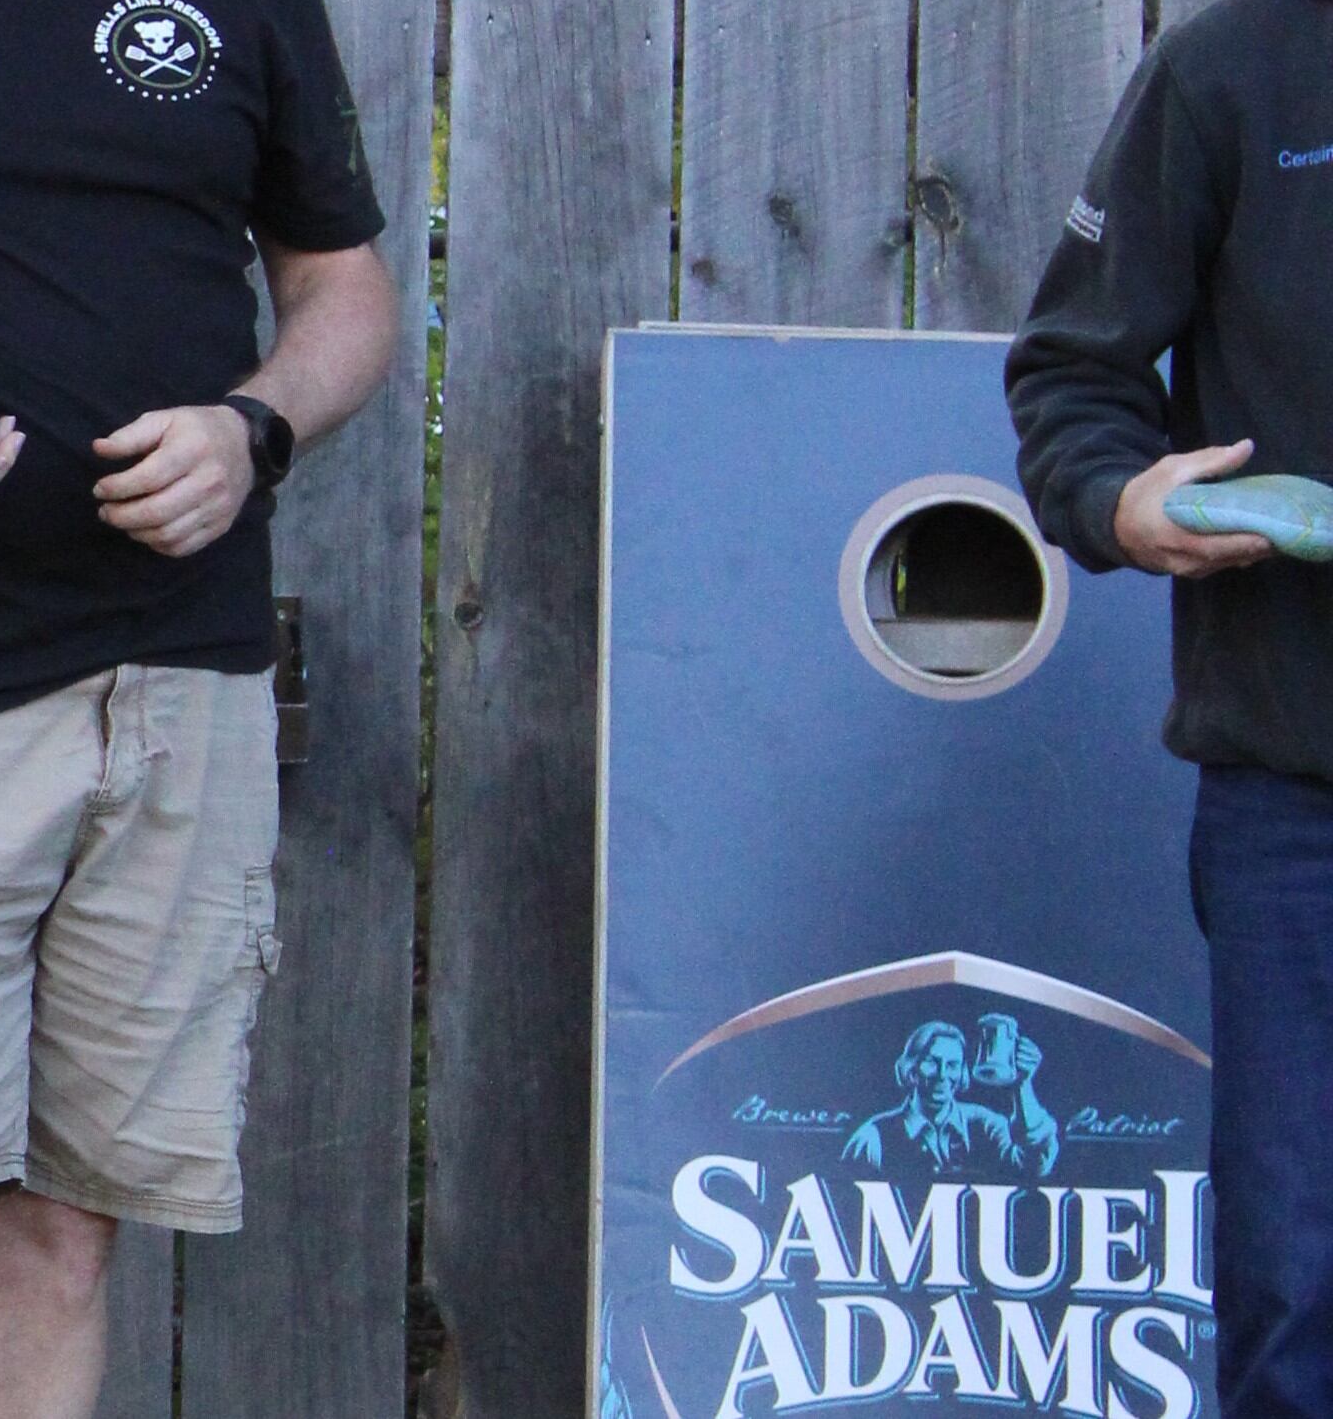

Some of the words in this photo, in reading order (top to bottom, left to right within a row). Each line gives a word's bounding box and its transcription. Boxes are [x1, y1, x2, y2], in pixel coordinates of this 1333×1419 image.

[94, 3, 126, 53] SMELLS
[732, 1092, 853, 1124] Brewer
[669, 1154, 1215, 1308] SAMUEL
[715, 1293, 1201, 1419] ADAMS
